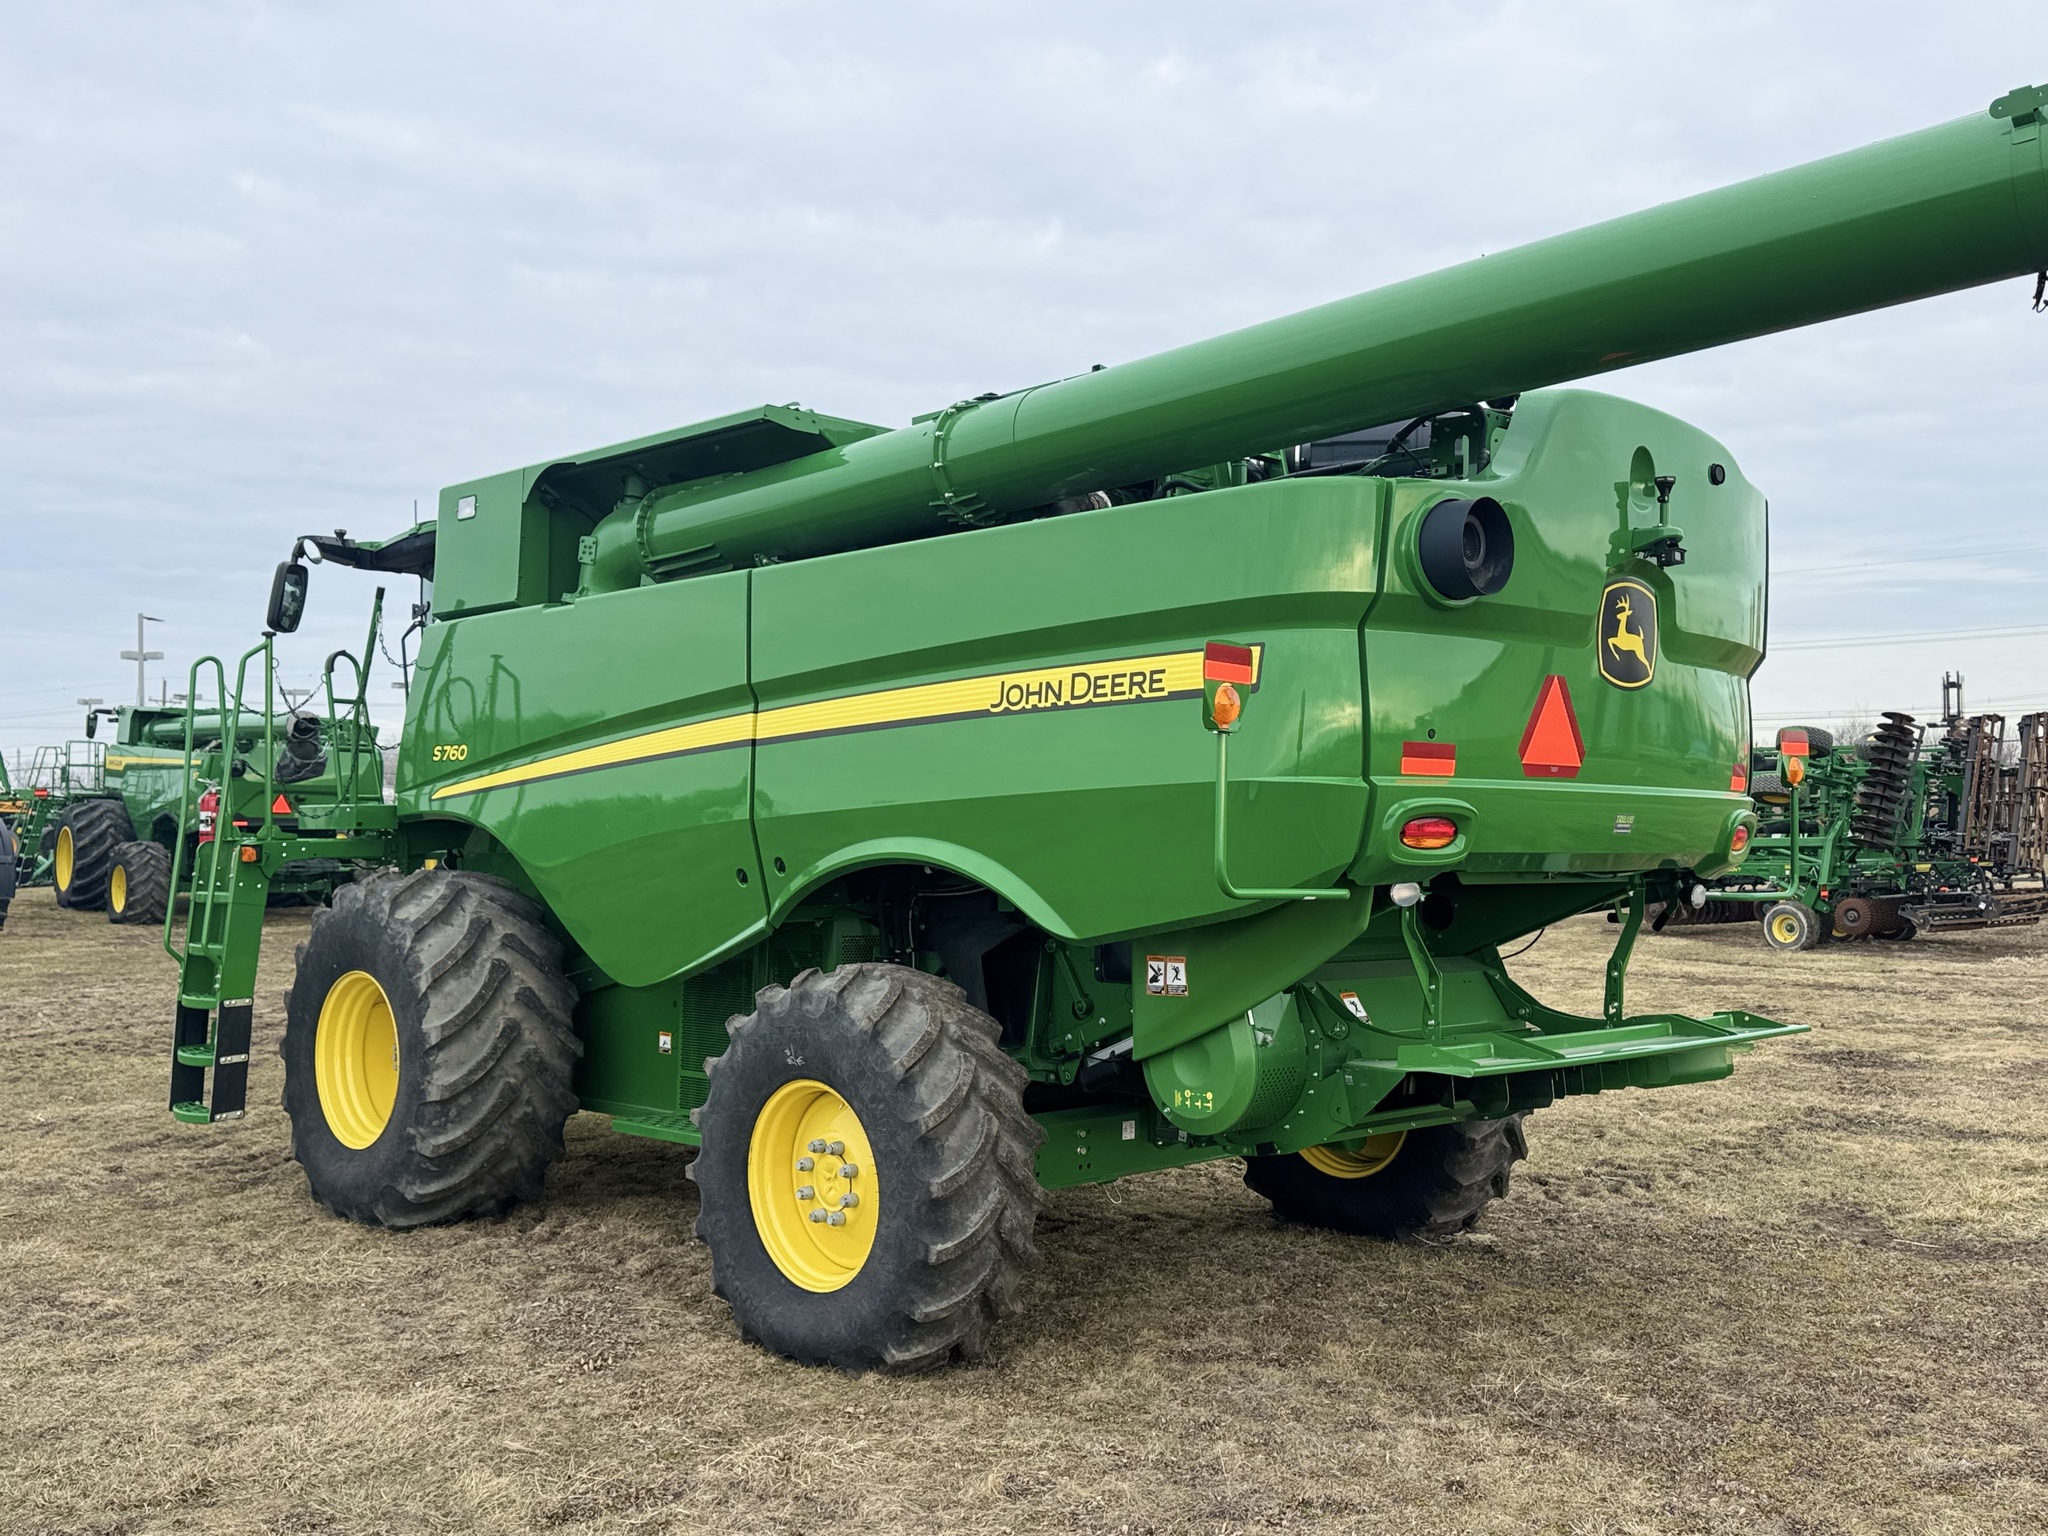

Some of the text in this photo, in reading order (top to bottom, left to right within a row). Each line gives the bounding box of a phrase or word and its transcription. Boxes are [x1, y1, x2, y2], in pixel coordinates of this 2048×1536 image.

[990, 669, 1167, 708] JOHN DEERE
[432, 744, 468, 762] S760
